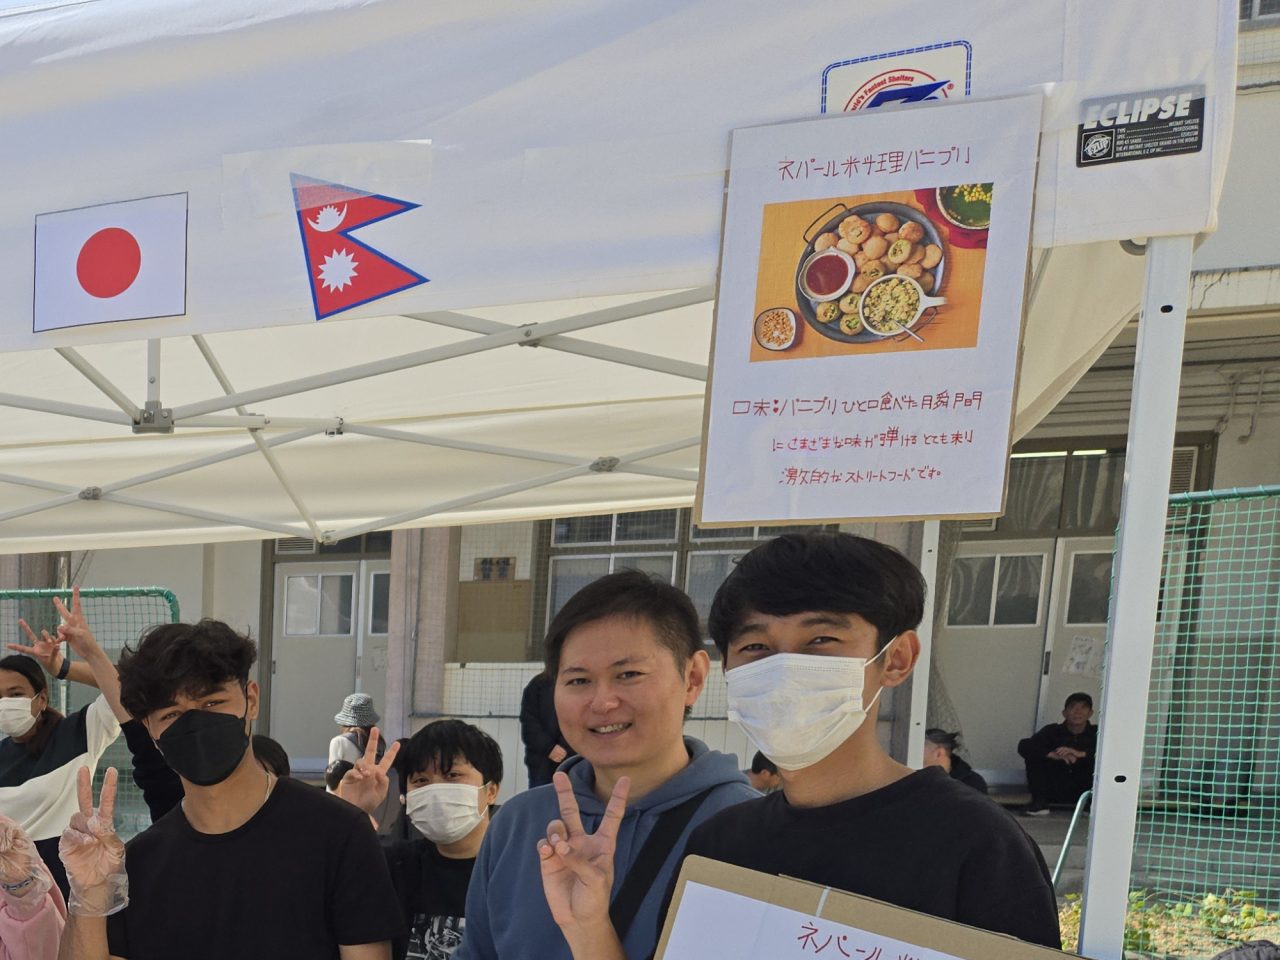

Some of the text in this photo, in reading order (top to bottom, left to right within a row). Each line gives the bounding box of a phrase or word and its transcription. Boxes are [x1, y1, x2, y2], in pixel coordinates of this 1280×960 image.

[864, 78, 888, 96] Fastest
[888, 75, 914, 83] Shelters
[1083, 93, 1192, 129] ECLIPSE
